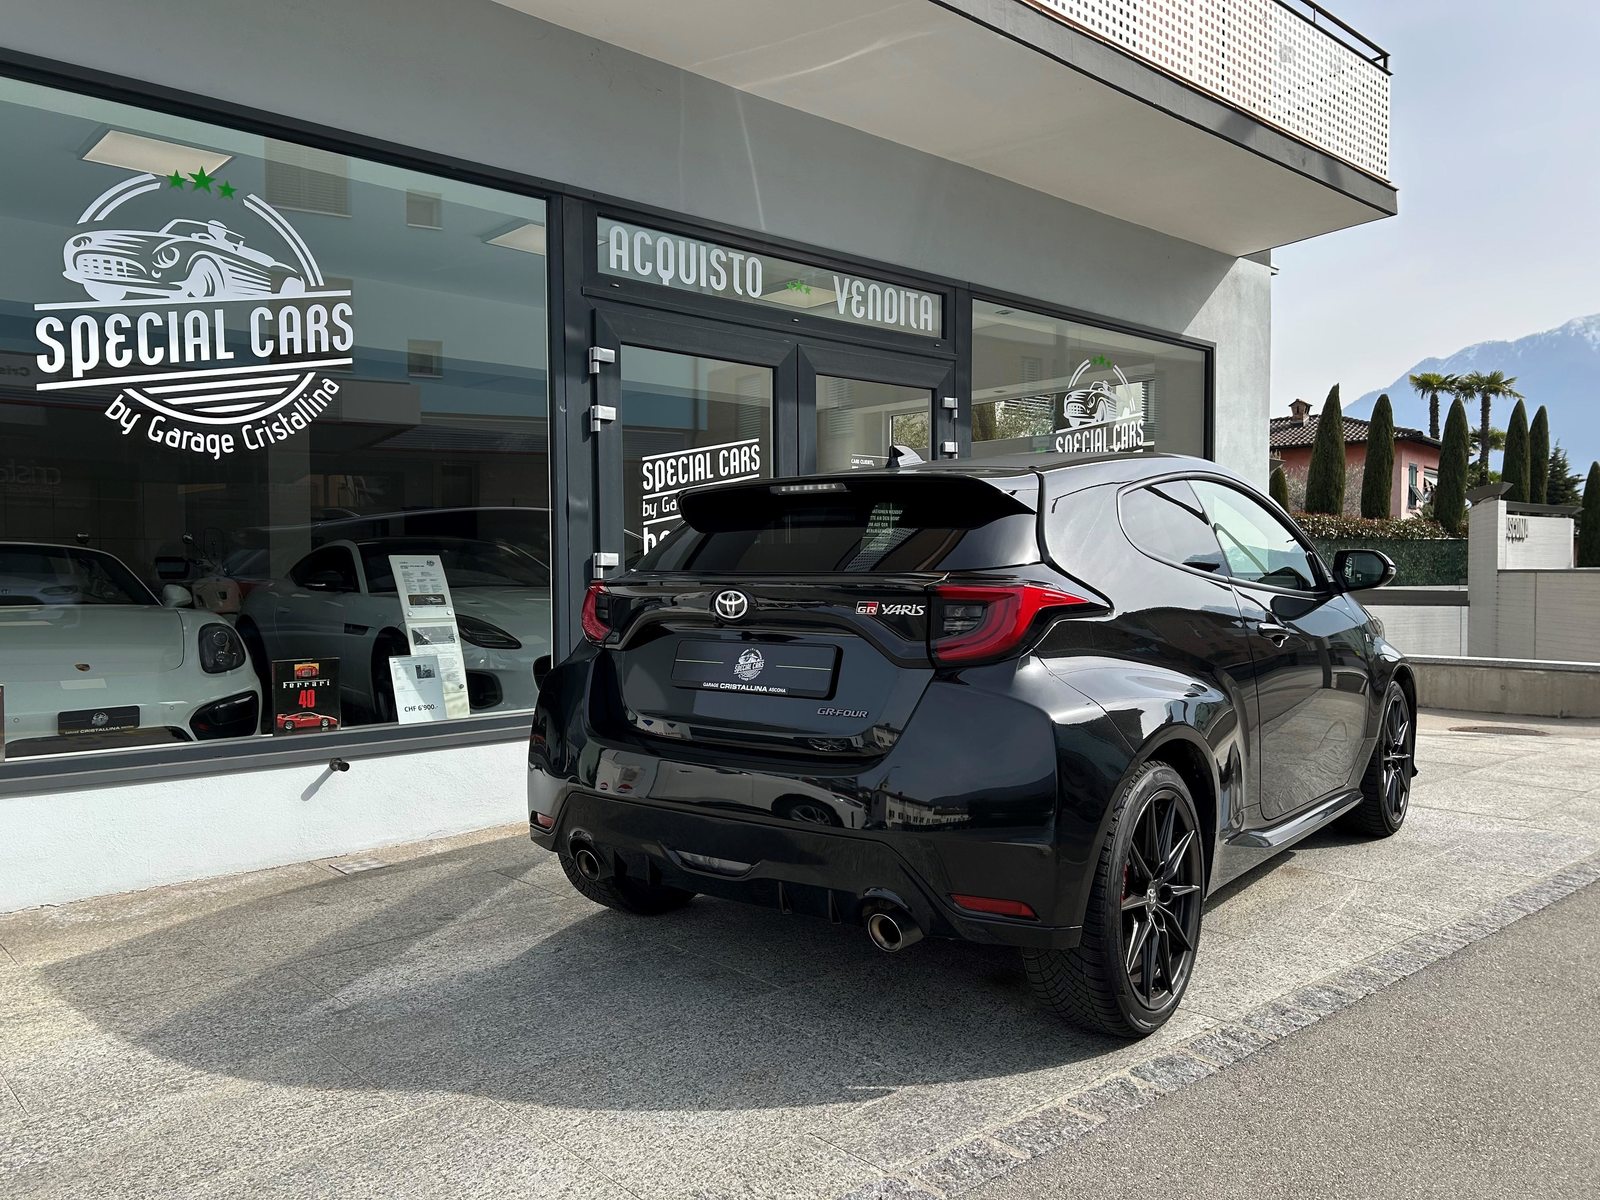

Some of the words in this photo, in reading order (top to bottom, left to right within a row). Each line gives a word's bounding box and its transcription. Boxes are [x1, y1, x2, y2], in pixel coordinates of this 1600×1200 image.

[608, 225, 763, 298] ACQUISTO
[833, 275, 933, 331] VENDITA
[35, 309, 235, 378] SPECIAL
[250, 302, 354, 358] CARS
[104, 394, 142, 435] by
[147, 415, 235, 460] Garage
[241, 377, 340, 450] Cristallina
[1113, 420, 1145, 453] CARS
[642, 452, 714, 492] SPECIAL
[719, 444, 761, 477] CARS
[642, 500, 658, 519] by
[856, 604, 878, 614] GR
[283, 679, 331, 689] Ferrari
[719, 682, 768, 692] CRISTALLINA
[299, 689, 315, 708] 40
[817, 707, 868, 718] GR-FOUR
[80, 726, 120, 734] CRISTALLINA
